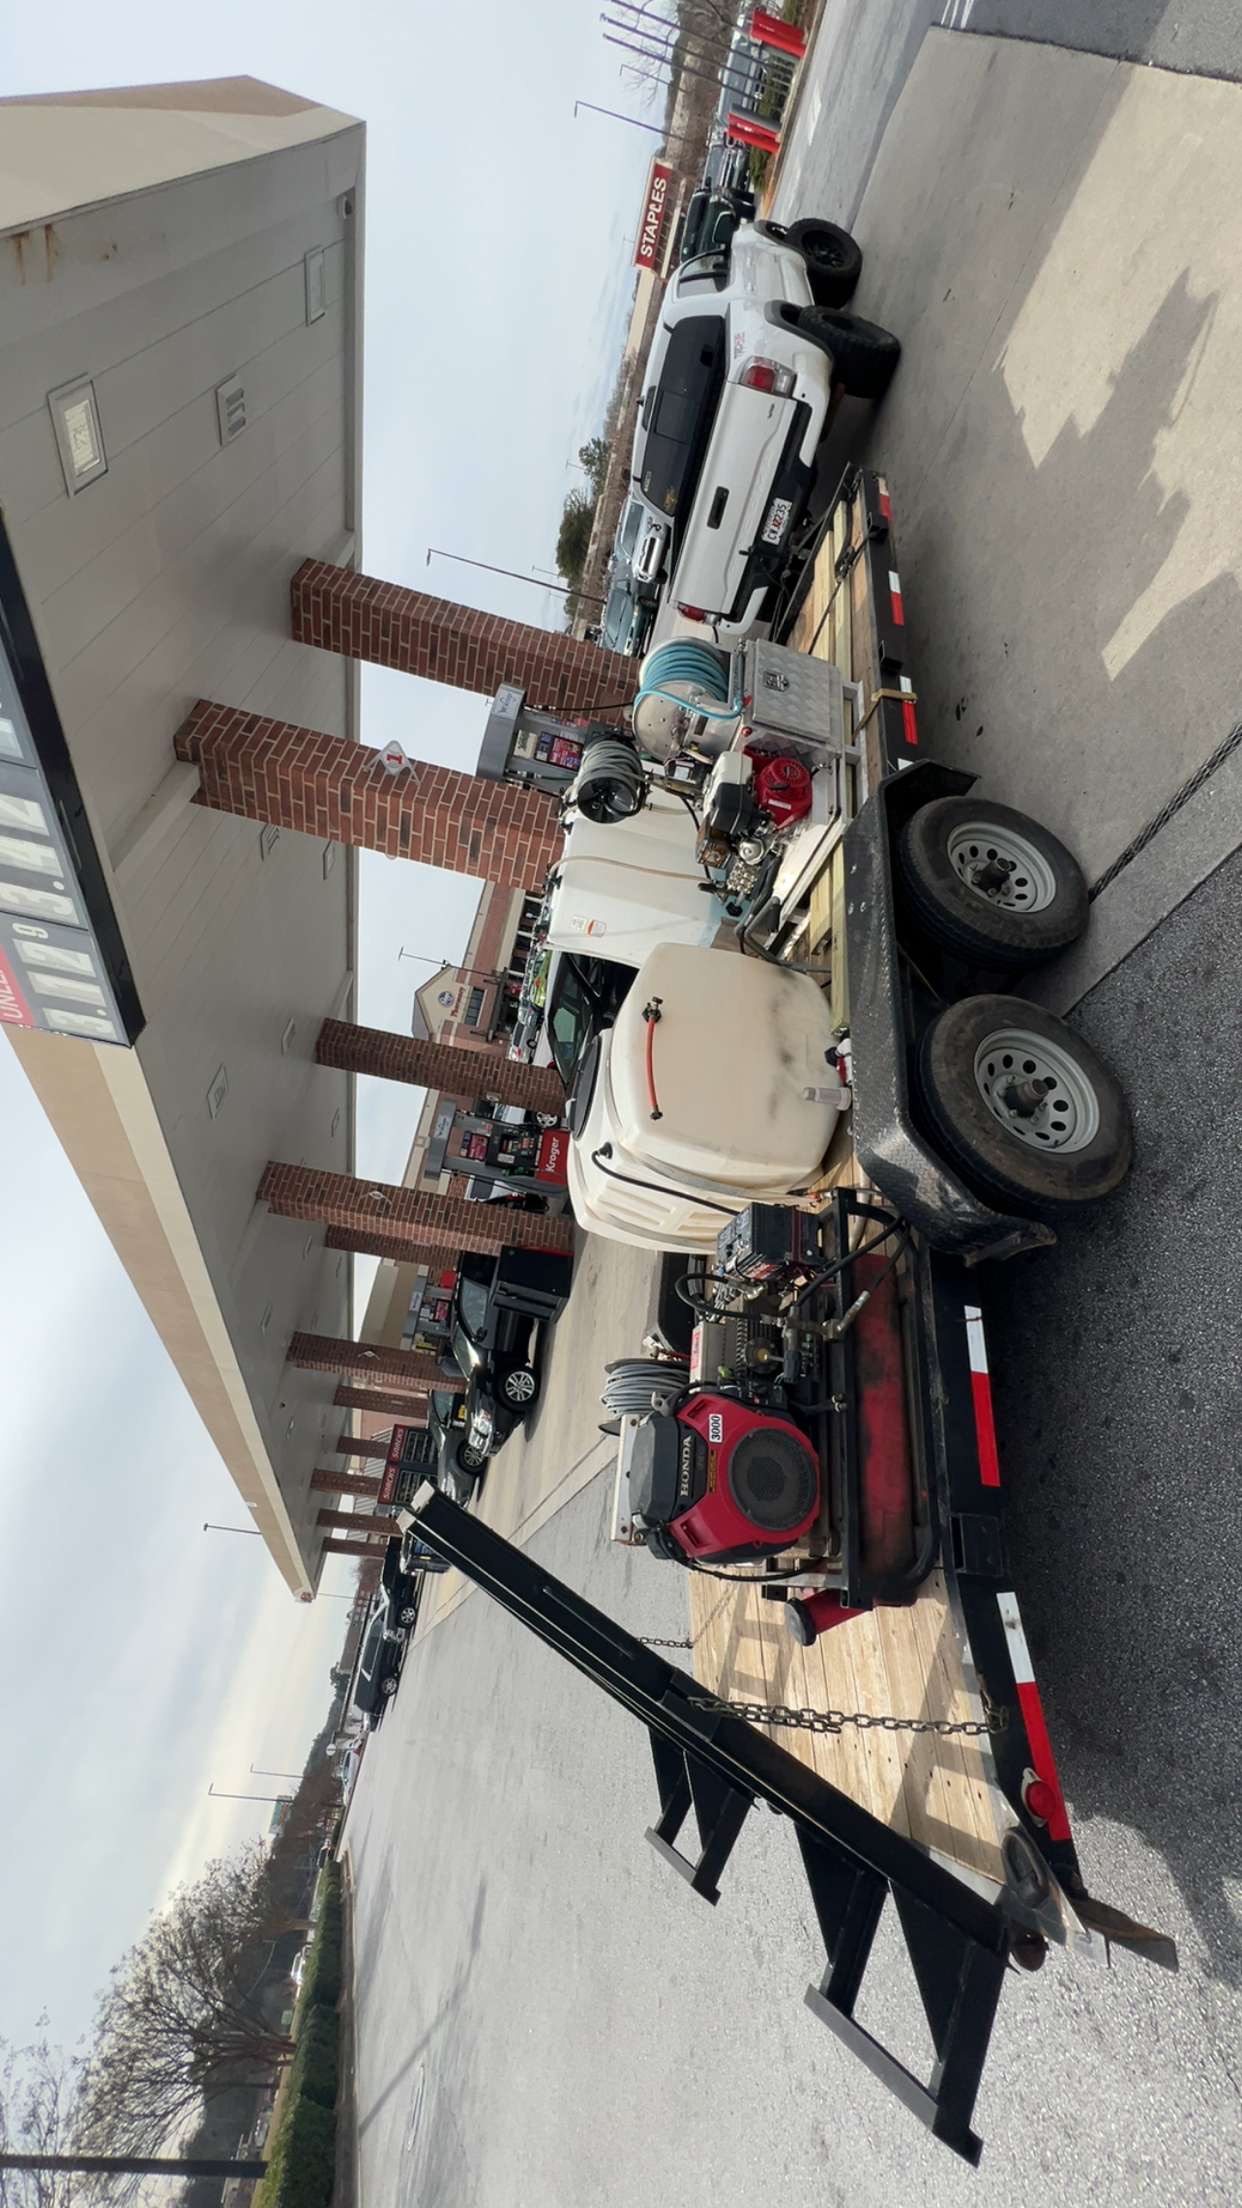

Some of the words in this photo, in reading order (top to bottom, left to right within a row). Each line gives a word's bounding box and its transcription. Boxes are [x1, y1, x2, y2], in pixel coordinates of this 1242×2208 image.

[640, 177, 667, 257] STAPLES
[386, 753, 402, 765] 1
[545, 1137, 560, 1172] Kroger
[710, 1415, 721, 1441] 3000
[680, 1435, 692, 1497] HONDA
